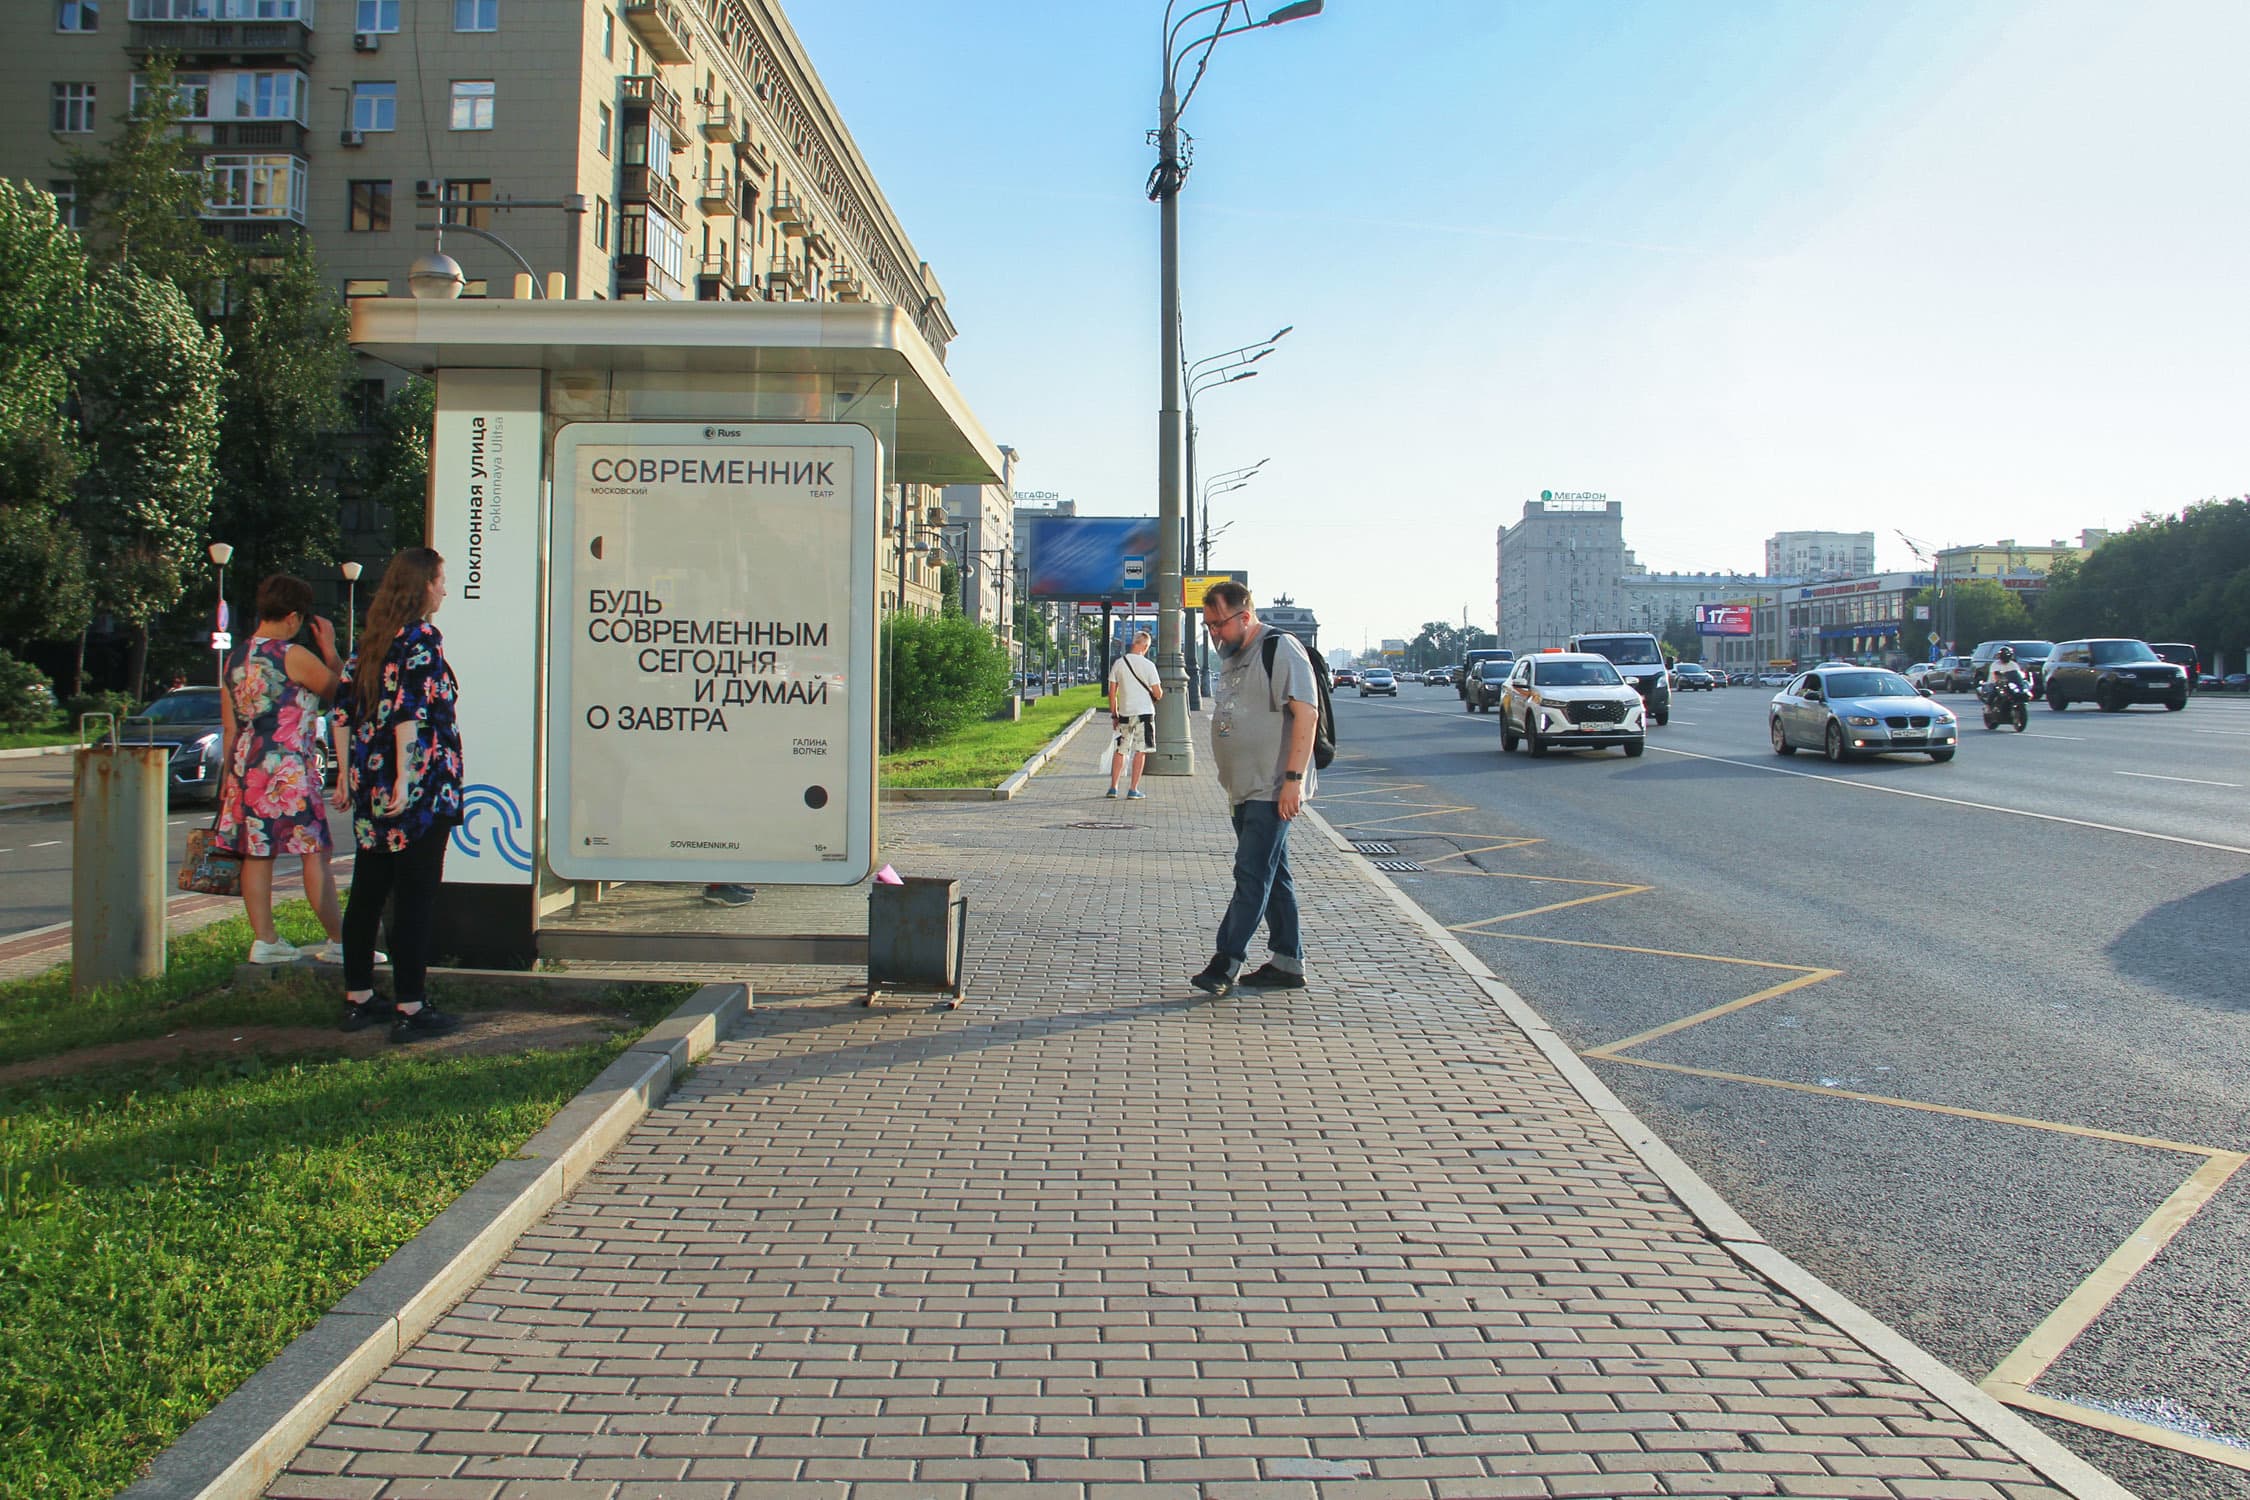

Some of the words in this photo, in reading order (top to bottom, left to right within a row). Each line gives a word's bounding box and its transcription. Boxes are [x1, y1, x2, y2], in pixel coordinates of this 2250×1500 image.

[491, 416, 504, 452] Ulitsa
[717, 429, 741, 437] Russ
[471, 417, 487, 478] улица
[591, 458, 835, 486] СОВРЕМЕННИК
[489, 457, 505, 531] Poklonnaya
[591, 487, 649, 495] МОСКОВСКИЙ
[809, 490, 834, 498] ТЕАТР
[463, 485, 483, 600] Поклонная
[589, 589, 663, 618] БУДЬ
[588, 618, 828, 647] СОВРЕМЕННЫМ
[638, 648, 777, 678] СЕГОДНЯ
[694, 678, 715, 703] И
[721, 674, 828, 707] ДУМАЙ
[586, 705, 610, 730] О
[617, 705, 729, 732] ЗАВТРА
[792, 738, 828, 746] ГАЛИНА
[792, 747, 828, 756] ВОЛЧЕК
[670, 840, 740, 850] SOVREMENNIK.RU
